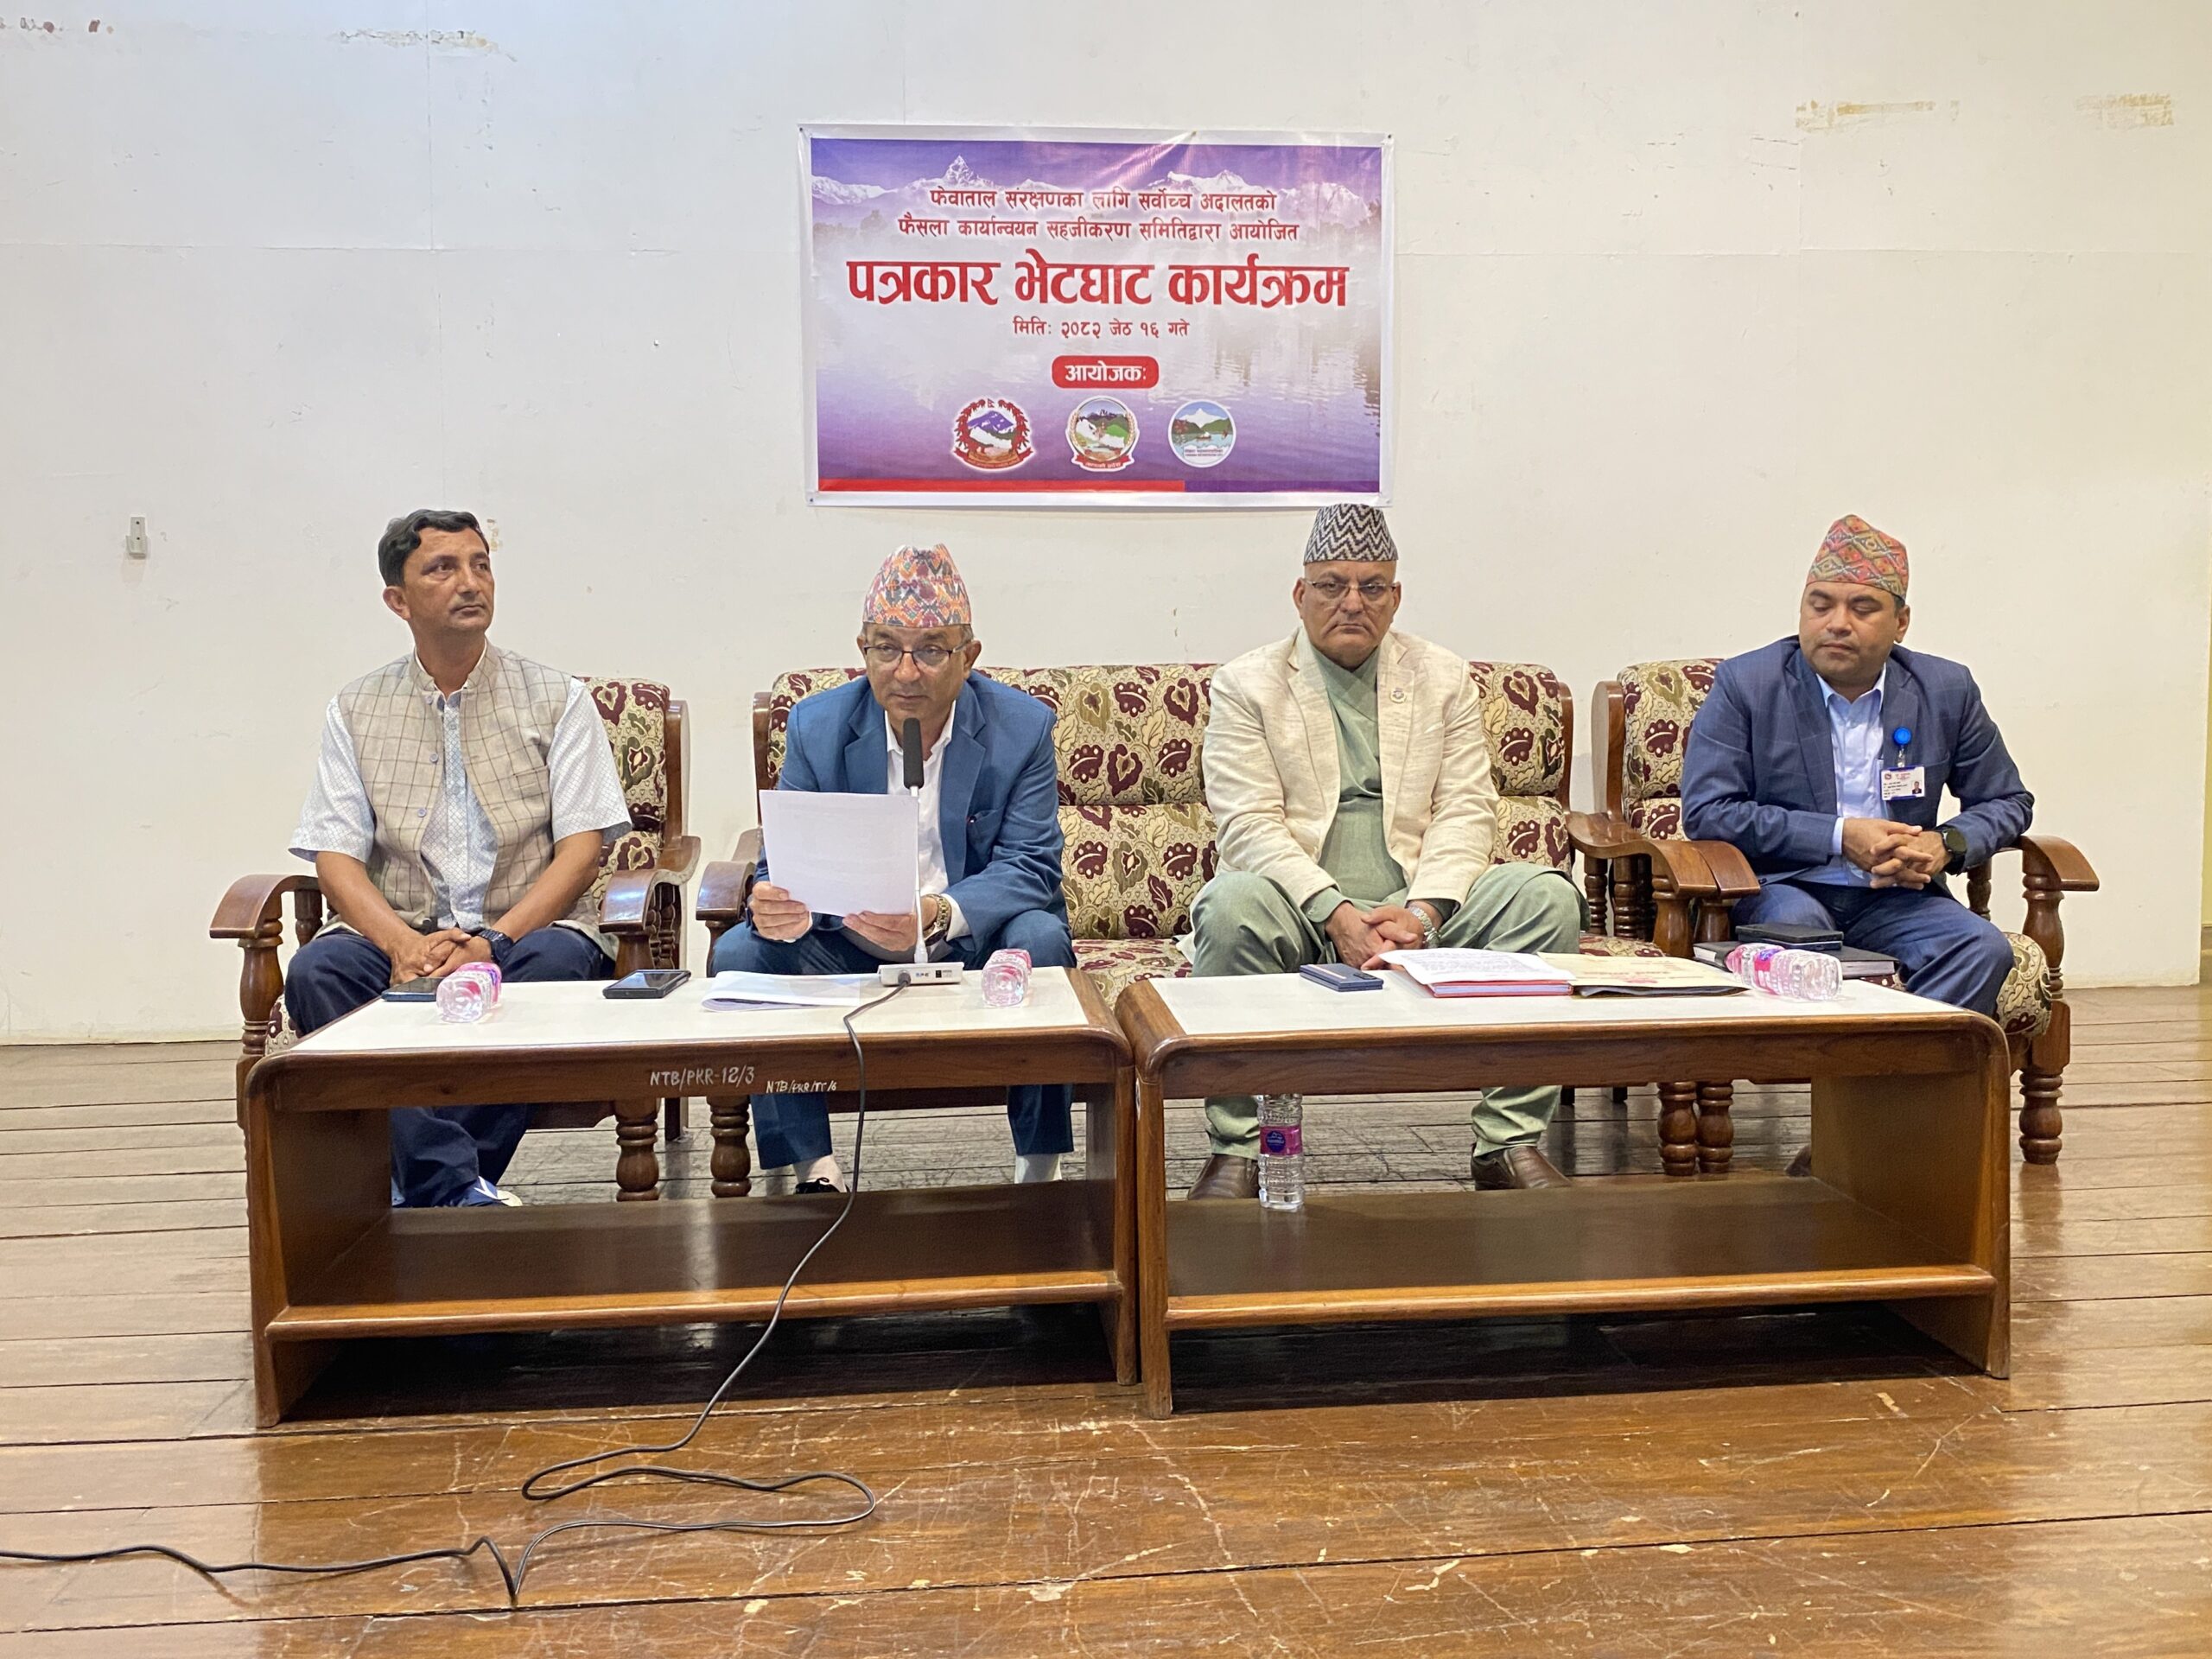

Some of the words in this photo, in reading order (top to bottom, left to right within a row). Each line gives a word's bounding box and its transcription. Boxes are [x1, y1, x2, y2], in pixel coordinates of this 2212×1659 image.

[930, 186, 997, 207] फेवाताल
[1005, 188, 1084, 210] संरक्षणका
[1092, 187, 1131, 209] लागि
[1138, 188, 1193, 211] सर्वोच्च
[1200, 190, 1277, 212] अदालतको
[898, 213, 950, 238] फैसला
[957, 215, 1039, 238] कार्यान्वयन
[1046, 217, 1132, 241] सहजीकरण
[1139, 218, 1222, 241] समितिद्वारा
[1230, 219, 1300, 241] आयोजित
[846, 261, 1001, 305] पत्रकार
[1014, 248, 1155, 305] भेटघाट
[1168, 253, 1350, 308] कार्यक्रम
[1061, 321, 1101, 339] २०८२
[1109, 318, 1133, 336] जेठ
[1140, 321, 1160, 338] १६
[1167, 319, 1190, 337] गते
